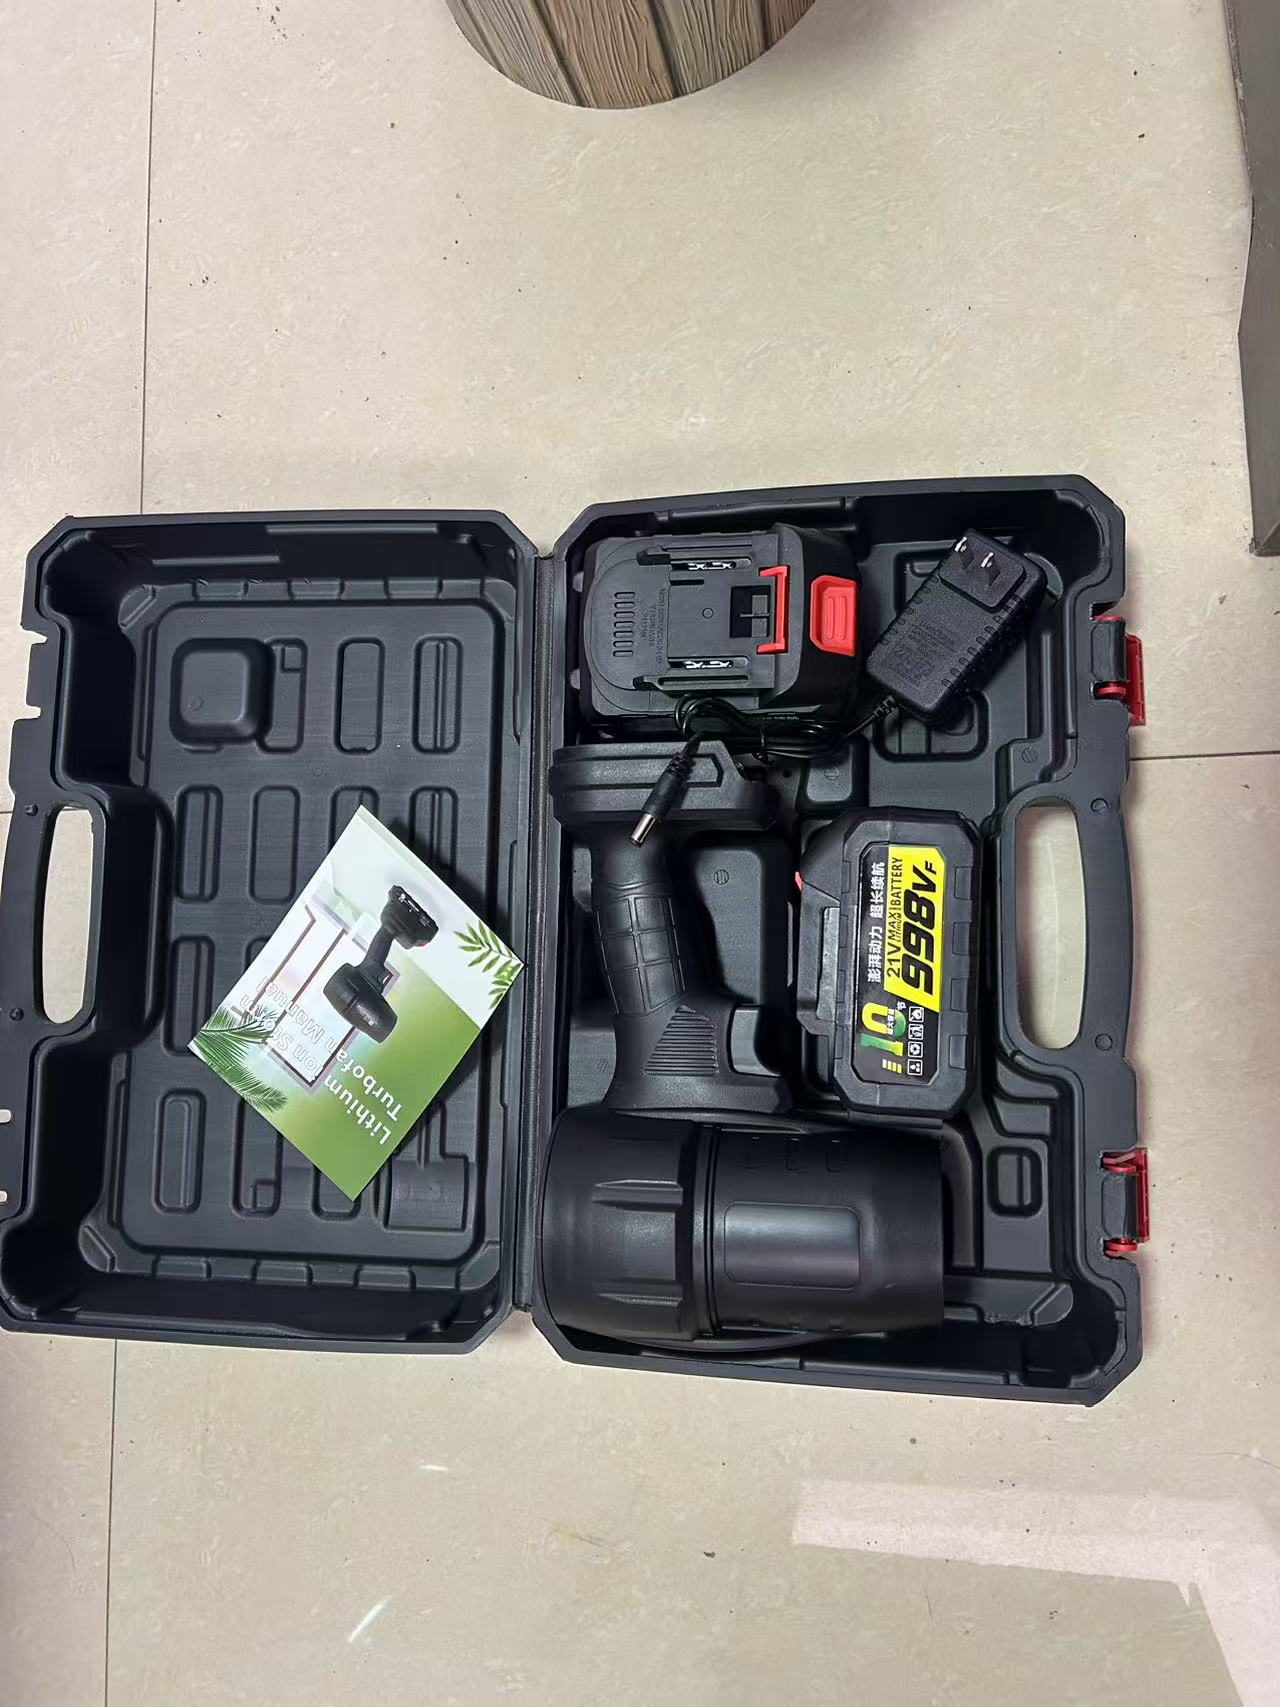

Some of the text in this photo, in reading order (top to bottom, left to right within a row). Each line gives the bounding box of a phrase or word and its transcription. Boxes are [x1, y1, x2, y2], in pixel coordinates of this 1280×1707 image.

[890, 856, 903, 906] BATTERY
[867, 862, 886, 983] 澎湃动力 超长续航
[887, 912, 897, 941] MAX
[886, 942, 901, 978] 21V
[240, 994, 294, 1051] Storm
[256, 976, 402, 1122] Turbofan Manual
[324, 1074, 392, 1146] Lithium
